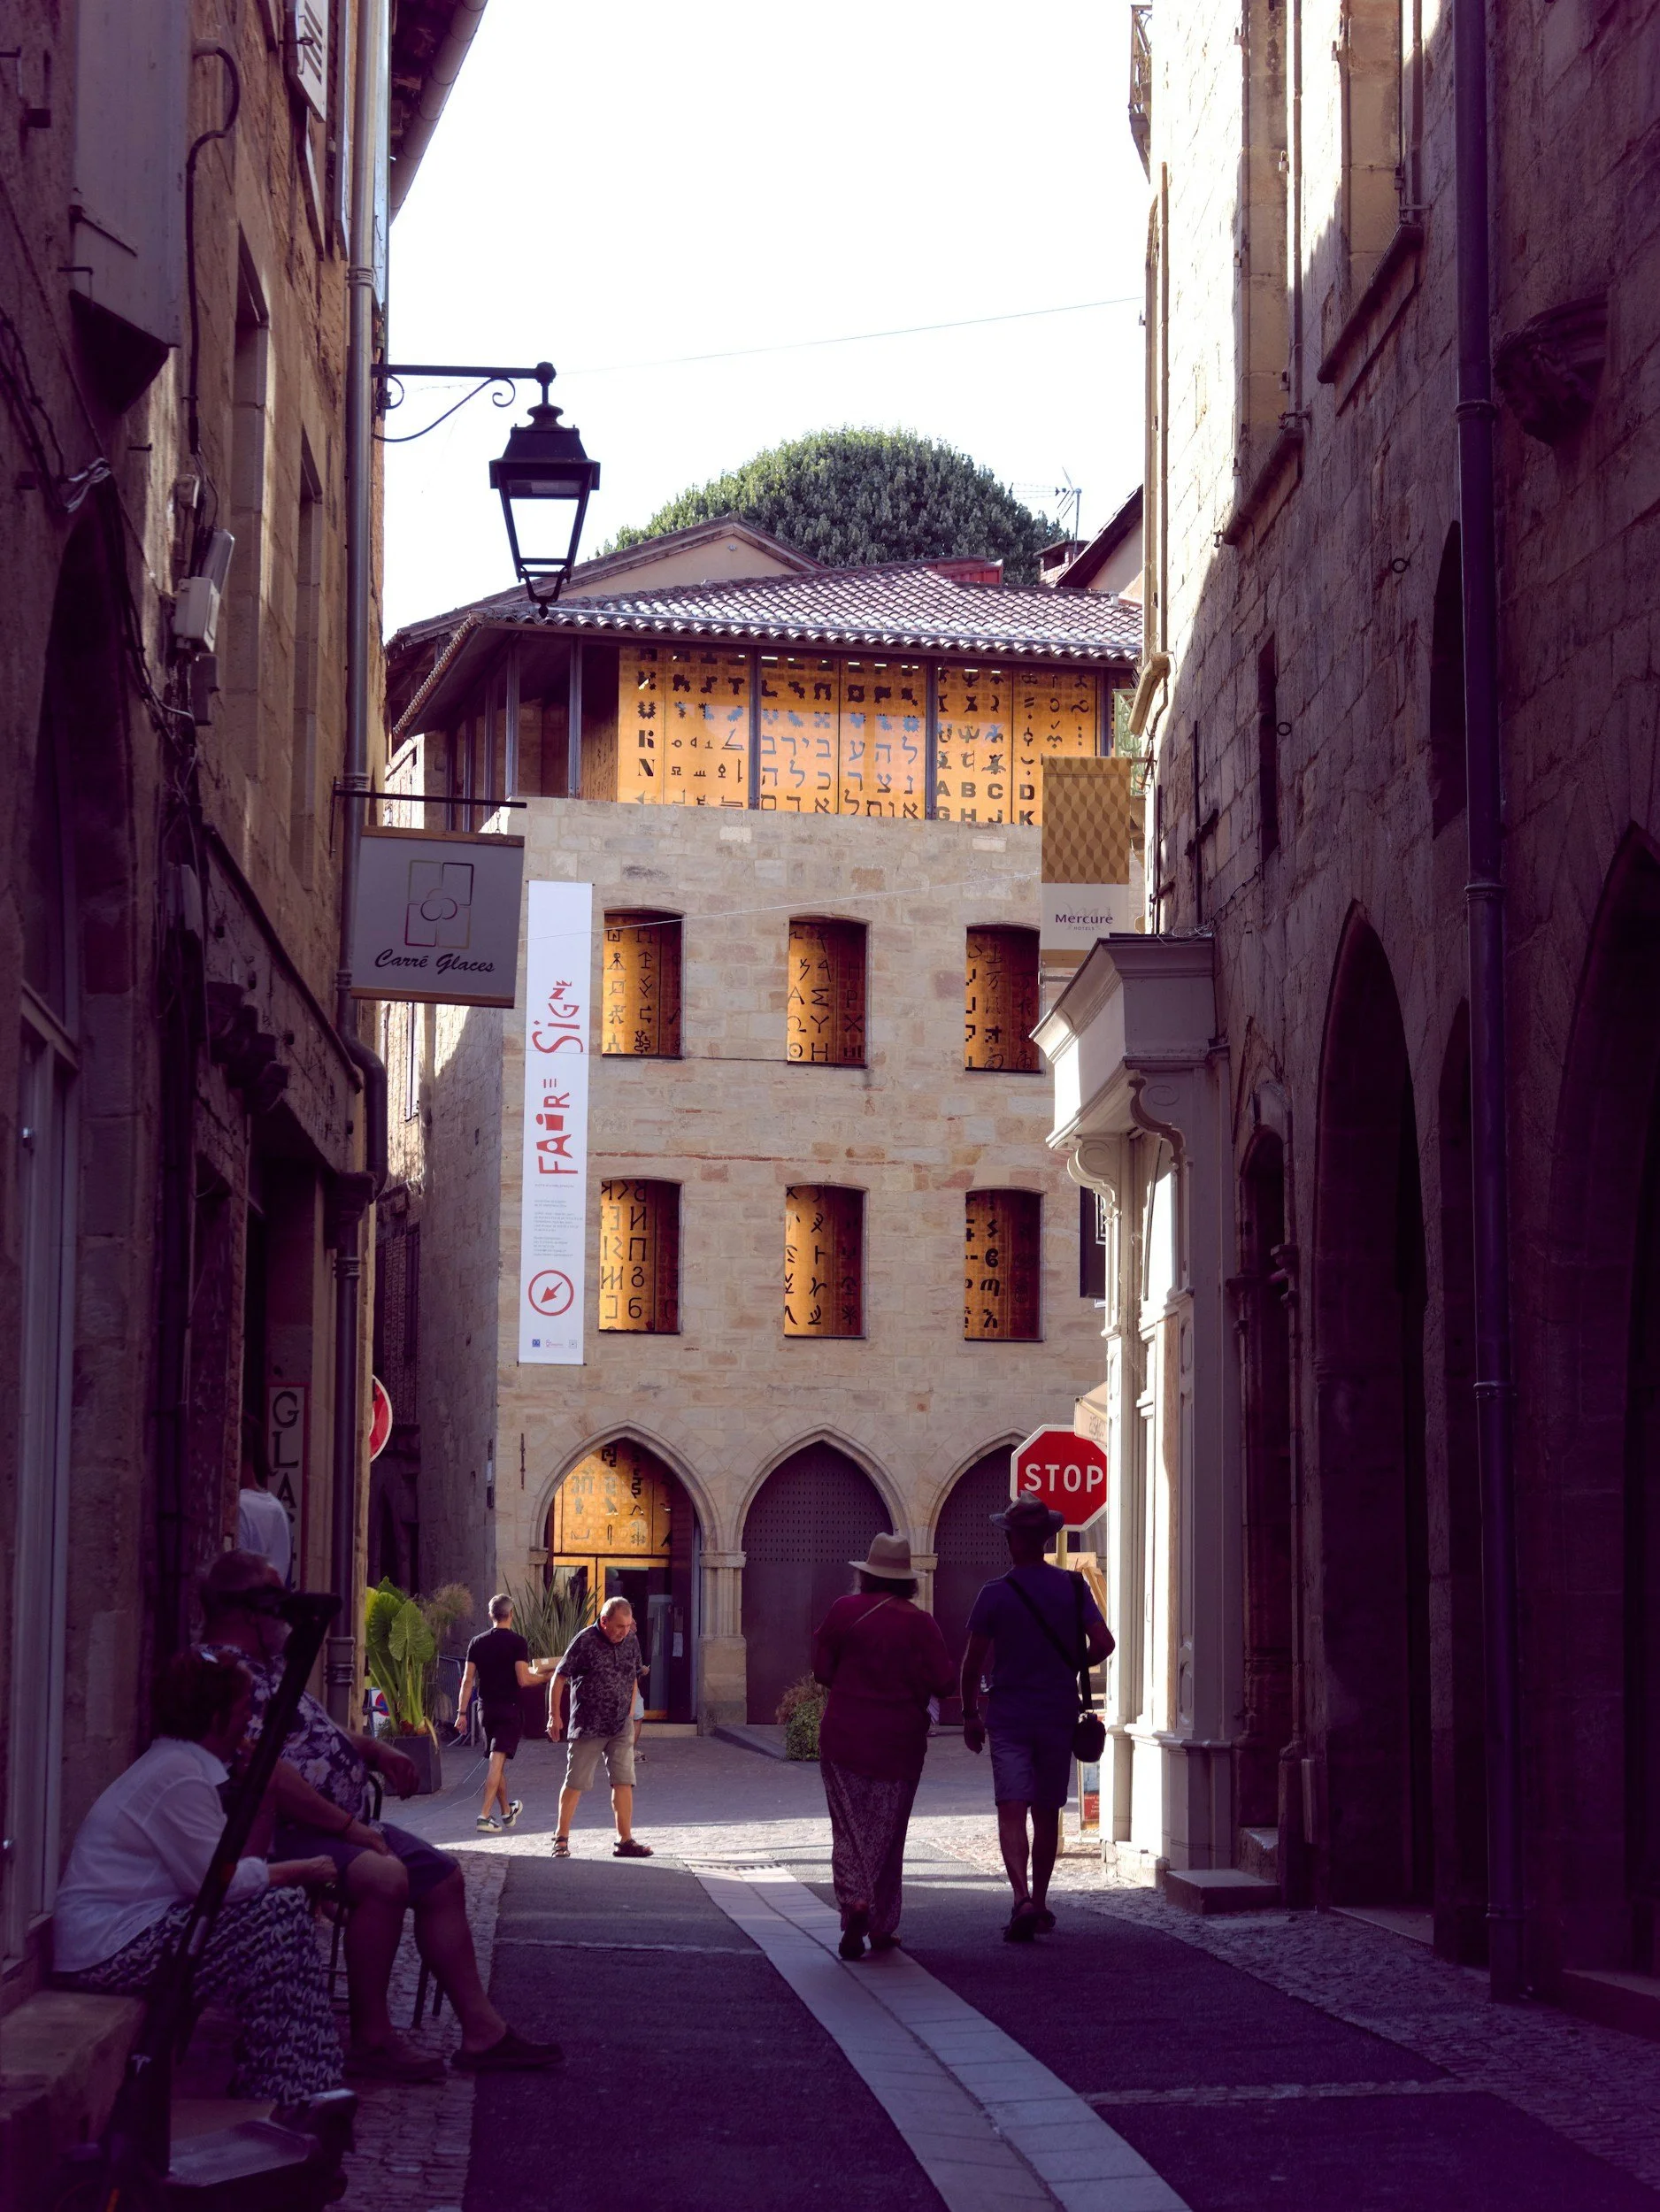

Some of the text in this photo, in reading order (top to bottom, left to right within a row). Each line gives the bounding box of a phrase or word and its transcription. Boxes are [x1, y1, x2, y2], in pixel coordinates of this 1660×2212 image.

[1055, 913, 1113, 925] Mercure
[374, 949, 496, 975] Carré Glaces
[1024, 1463, 1104, 1493] STOP
